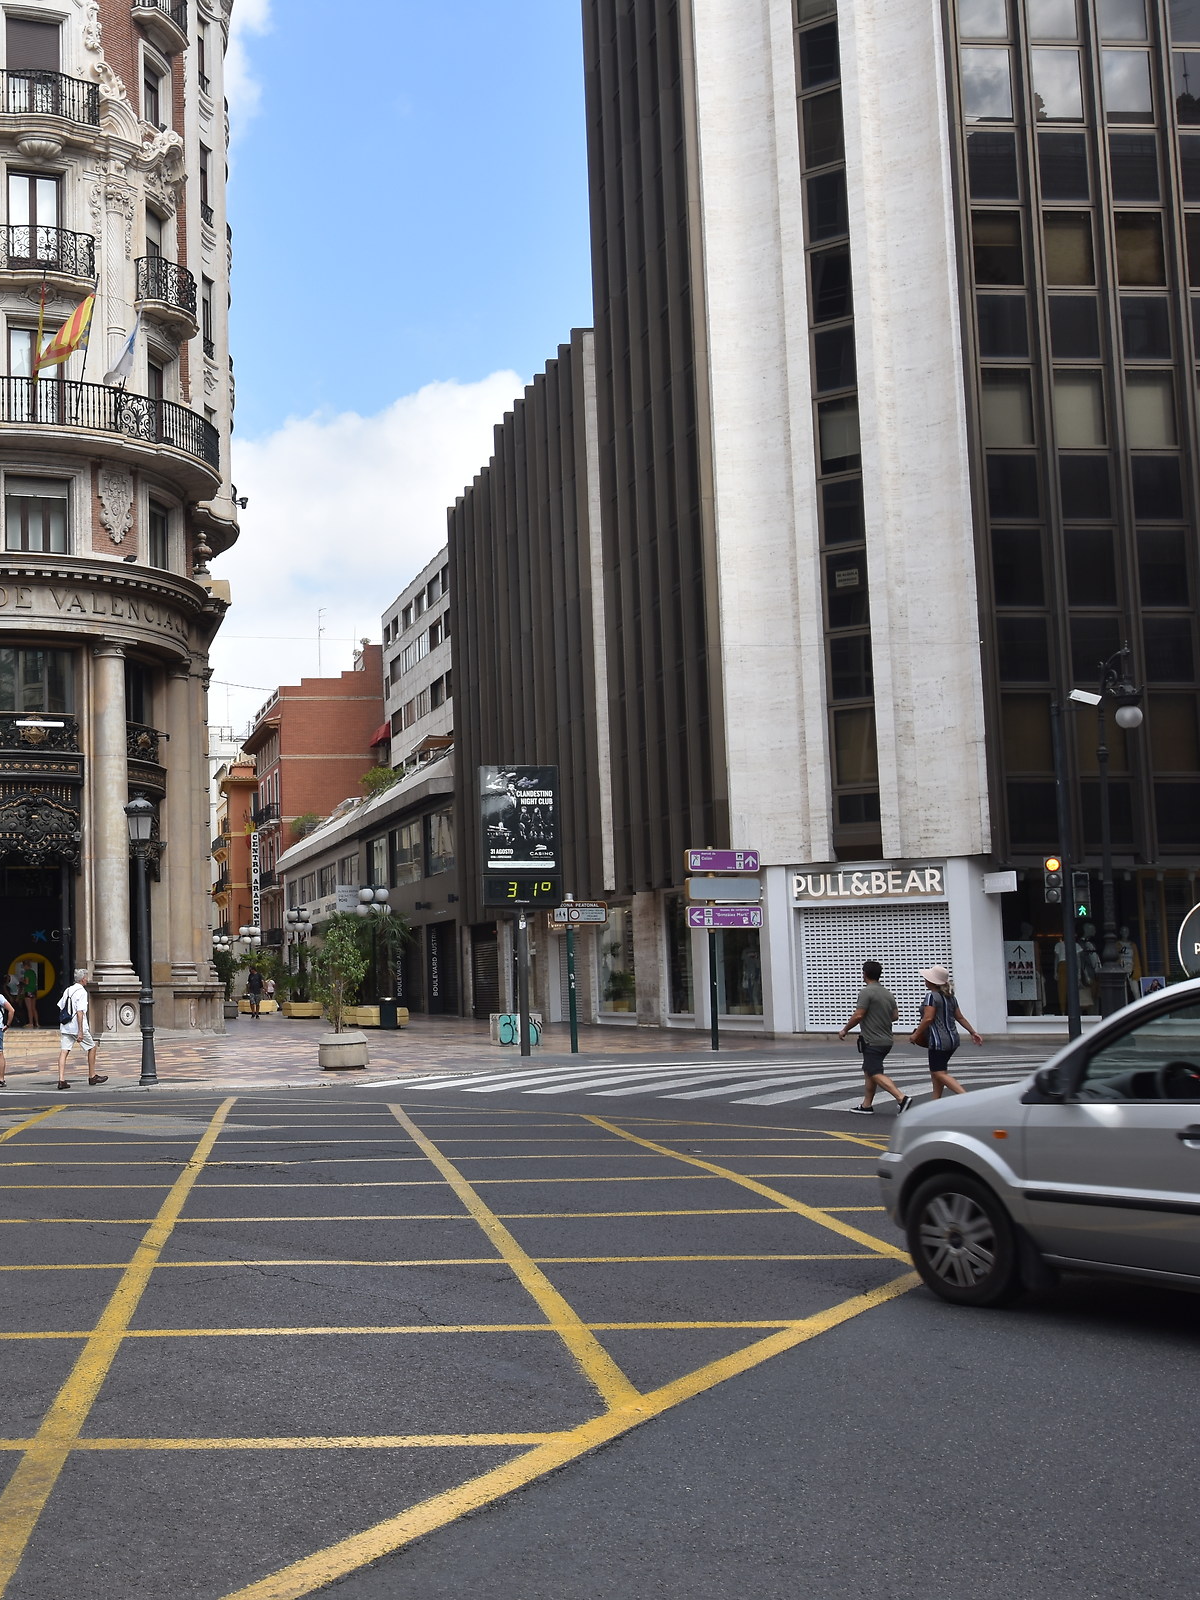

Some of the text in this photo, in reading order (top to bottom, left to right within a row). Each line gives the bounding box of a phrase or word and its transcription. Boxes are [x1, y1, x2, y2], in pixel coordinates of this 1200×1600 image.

[49, 587, 174, 631] VALENCIA
[516, 790, 553, 798] CLANDESTINO
[520, 797, 554, 805] NIGHT CLUB
[792, 869, 942, 898] PULL&BEAR
[1008, 961, 1033, 969] MAN
[431, 956, 439, 997] BOULEVARD
